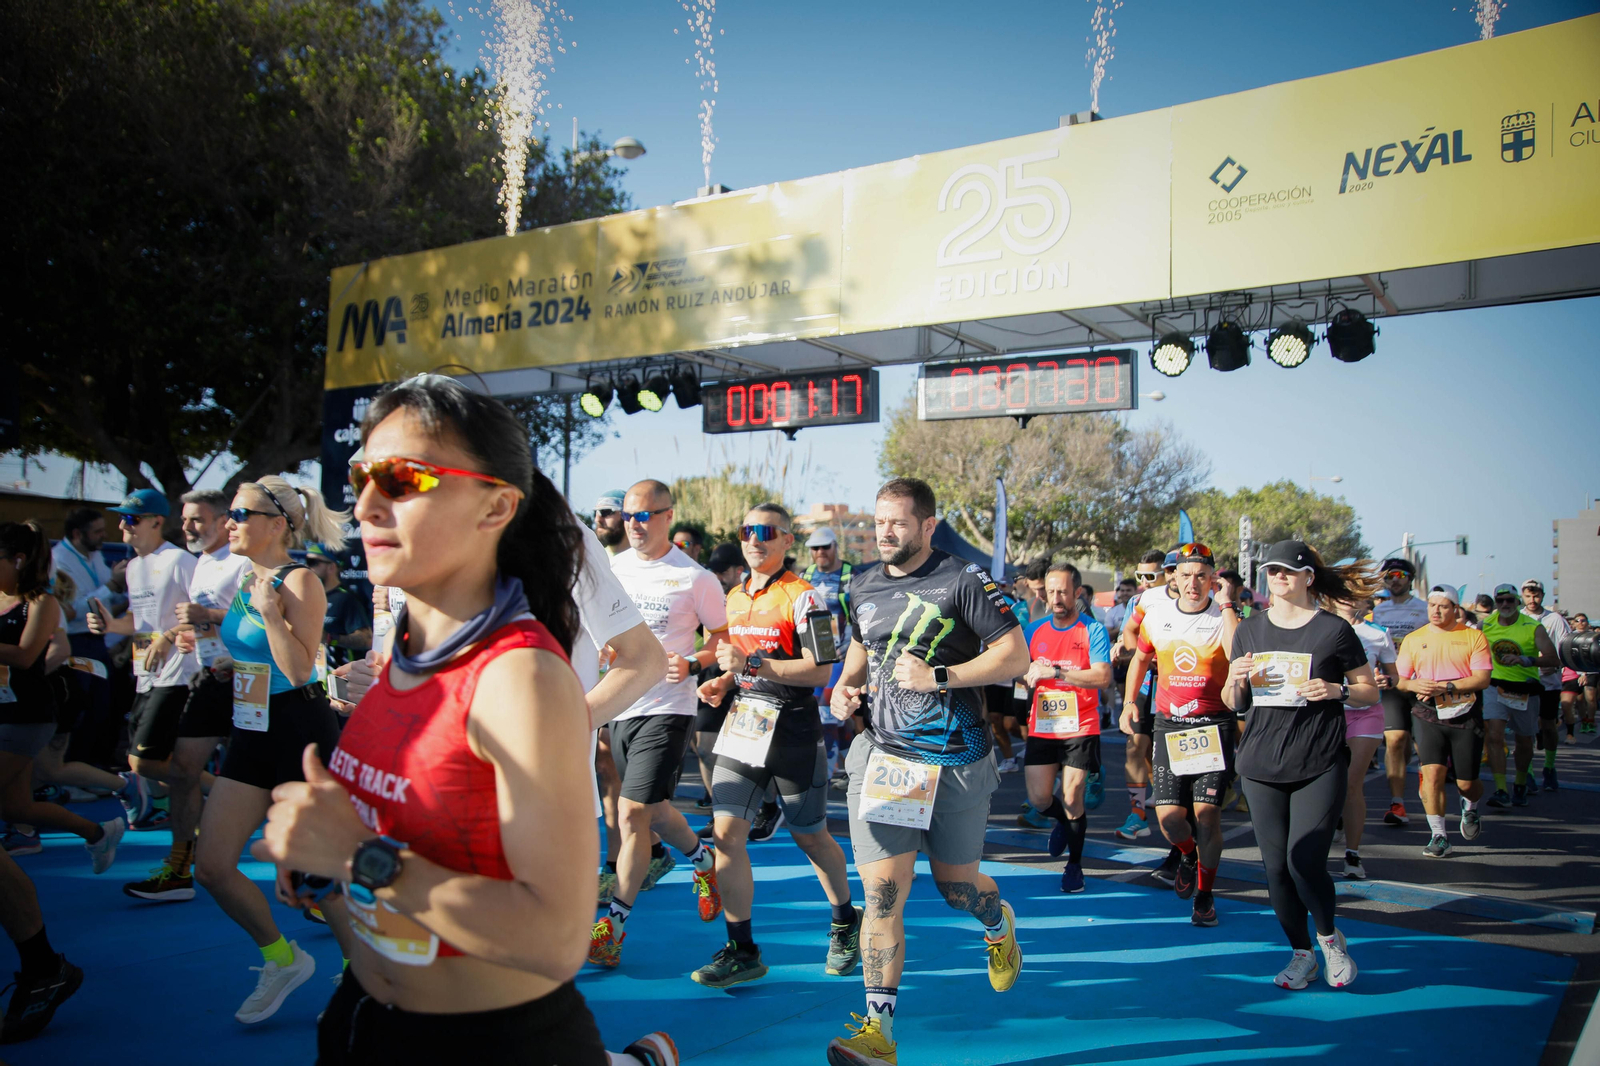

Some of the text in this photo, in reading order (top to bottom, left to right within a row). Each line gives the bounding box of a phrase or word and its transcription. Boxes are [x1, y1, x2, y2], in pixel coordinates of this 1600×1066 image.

[1338, 126, 1472, 194] NEXAL
[1208, 185, 1312, 212] COOPERACIÓN
[1349, 182, 1374, 193] 2020
[937, 148, 1071, 268] 25
[1208, 210, 1242, 224] 2005
[443, 268, 593, 309] Medio Maratón
[934, 258, 1070, 302] EDICIÓN
[604, 280, 792, 319] RAMÓN RUIZ ANDÚJAR
[441, 295, 591, 339] Almería 2024
[644, 602, 669, 612] 2024
[1042, 699, 1067, 712] 899
[1172, 716, 1211, 724] Europark
[1179, 735, 1209, 752] 530
[359, 763, 412, 804] TRACK
